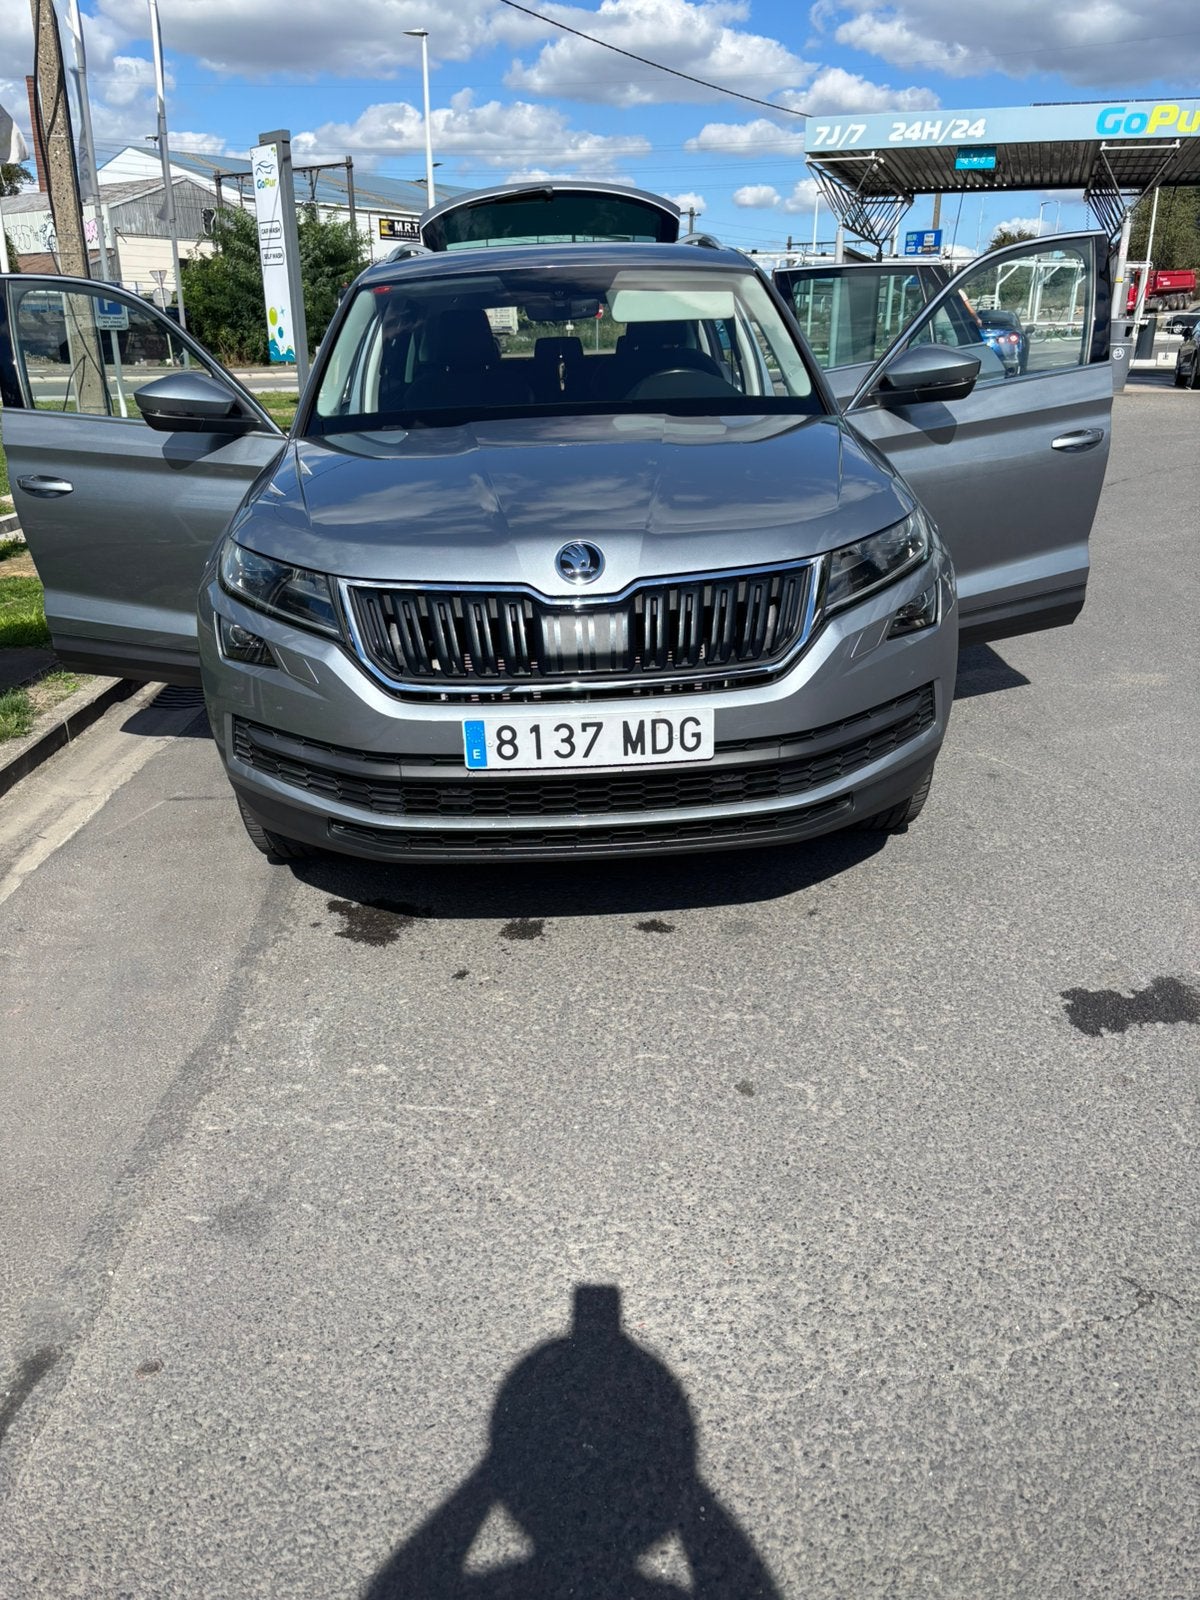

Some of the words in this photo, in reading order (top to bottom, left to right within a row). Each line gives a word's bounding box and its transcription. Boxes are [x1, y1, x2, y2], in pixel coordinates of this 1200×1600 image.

[814, 124, 867, 148] 7J/7
[888, 118, 987, 144] 24H/24
[496, 721, 604, 761] 8137
[622, 716, 702, 757] MDG
[473, 749, 481, 760] E
